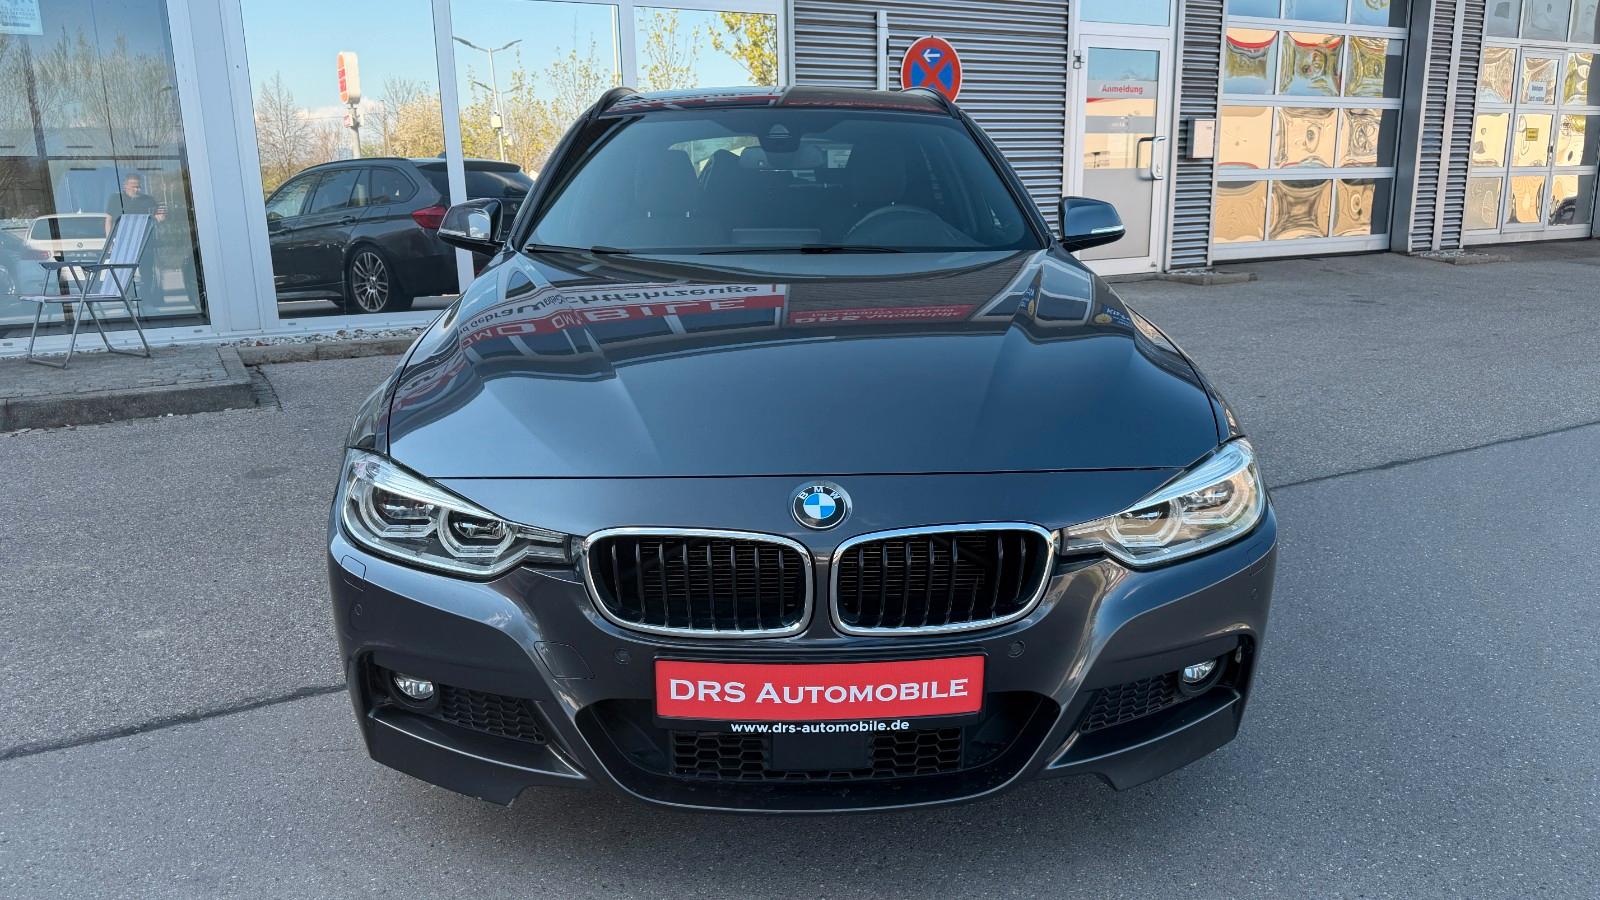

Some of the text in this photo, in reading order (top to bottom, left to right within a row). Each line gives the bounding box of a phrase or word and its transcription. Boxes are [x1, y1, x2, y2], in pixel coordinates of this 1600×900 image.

[1102, 84, 1144, 95] Anmeldung
[797, 486, 841, 500] BMW
[669, 679, 746, 703] DRS
[731, 719, 909, 733] www.drs-automobile.de
